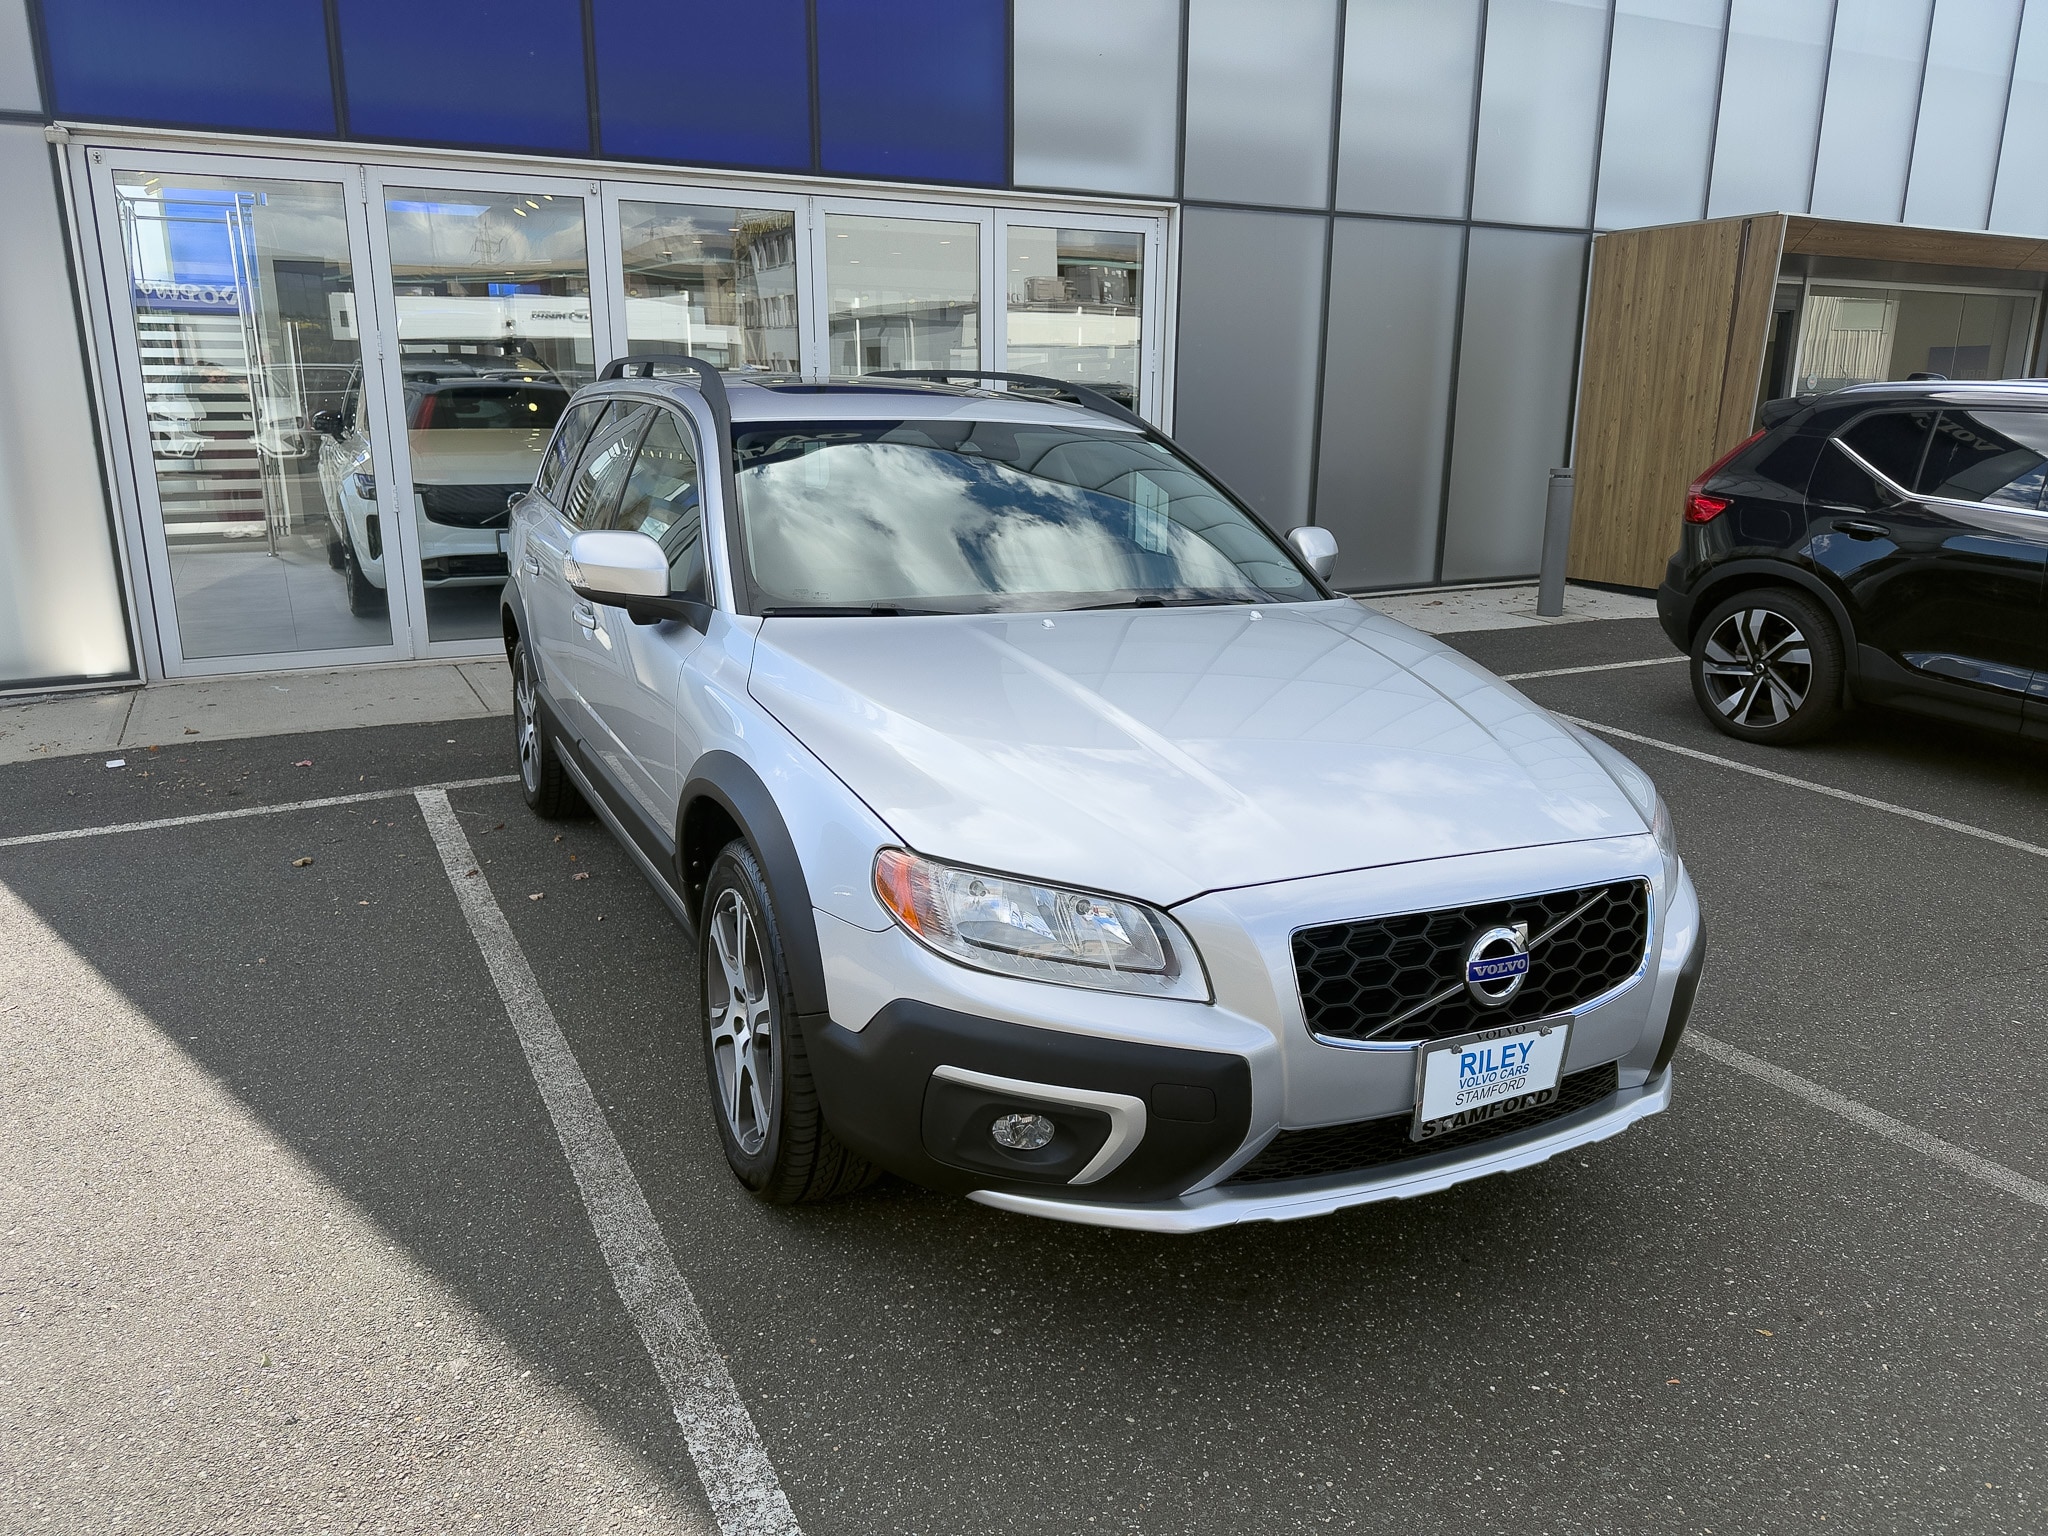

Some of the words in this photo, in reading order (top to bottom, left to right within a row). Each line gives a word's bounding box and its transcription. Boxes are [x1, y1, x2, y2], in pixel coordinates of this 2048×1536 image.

[1473, 959, 1526, 977] VOLVO
[1476, 1024, 1526, 1041] VOLVO
[1459, 1040, 1535, 1078] RILEY
[1459, 1072, 1498, 1089] VOLVO
[1499, 1063, 1530, 1079] CARS
[1455, 1078, 1526, 1106] STAMFORD
